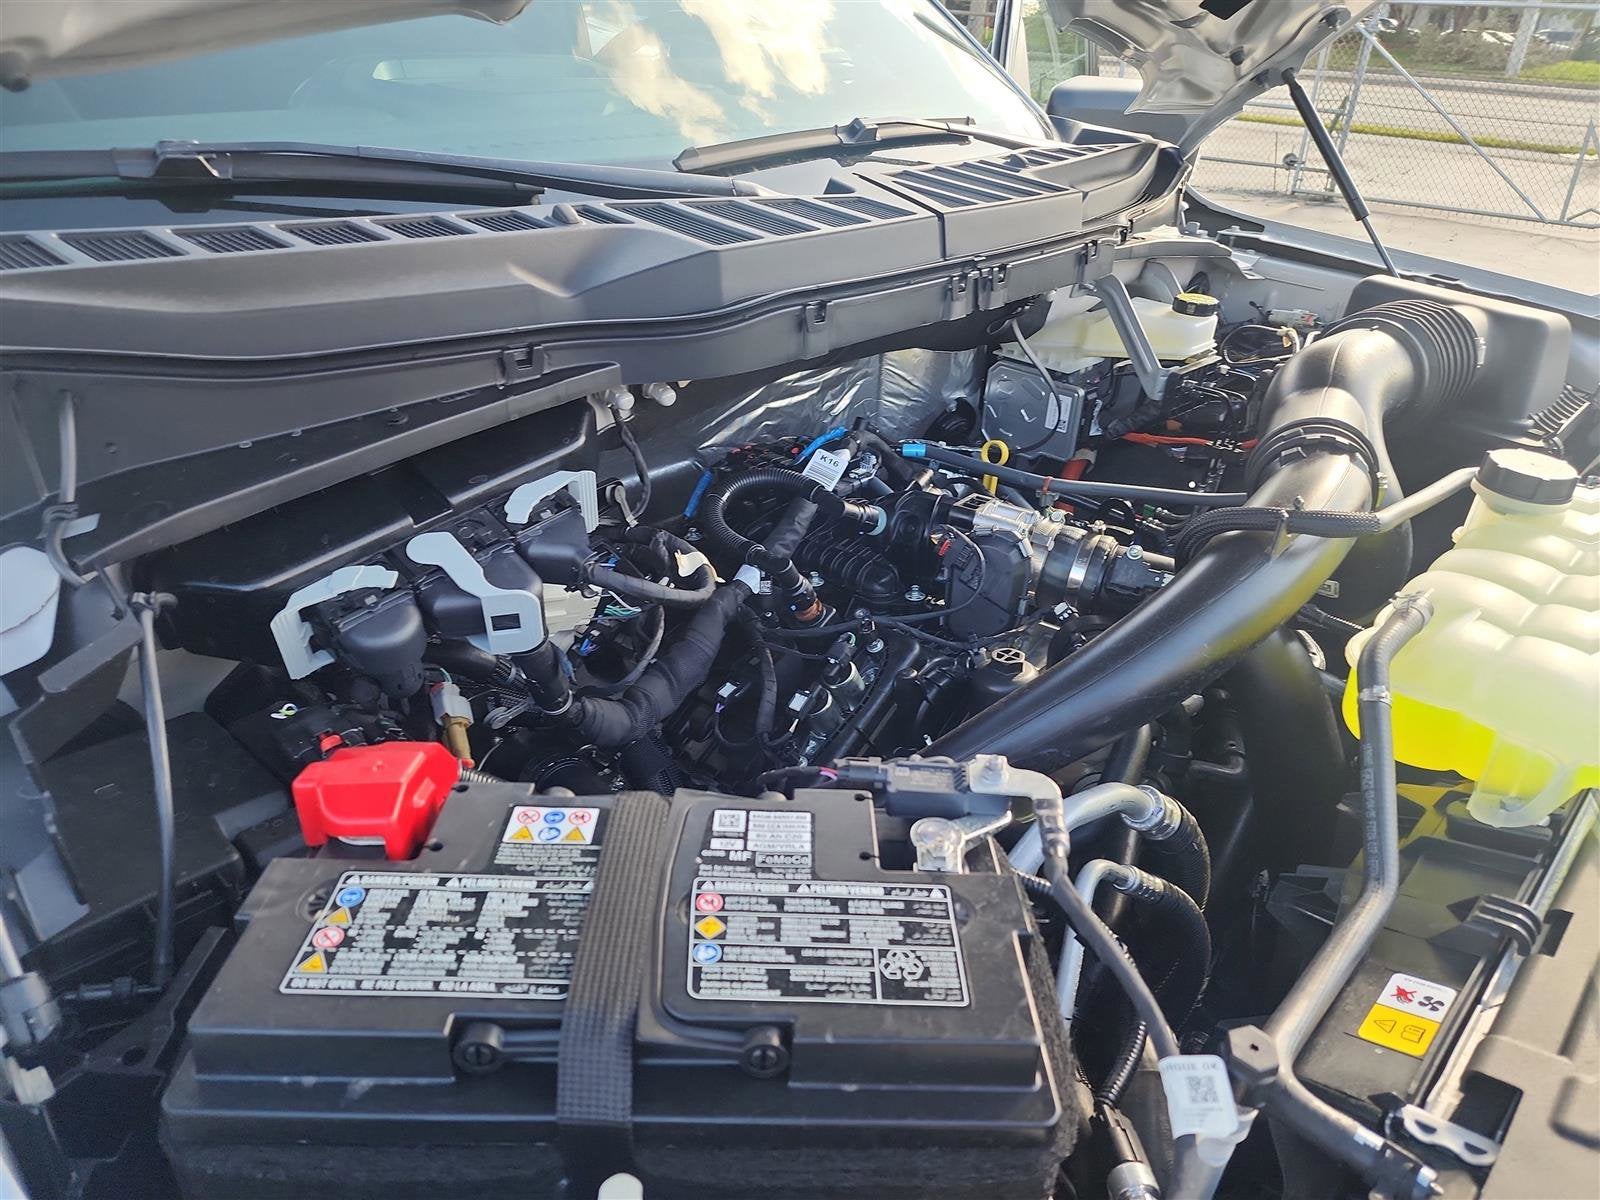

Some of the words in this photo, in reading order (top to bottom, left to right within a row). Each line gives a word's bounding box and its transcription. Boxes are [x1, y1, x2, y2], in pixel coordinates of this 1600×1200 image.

[820, 454, 839, 467] K16
[729, 850, 753, 861] MF
[759, 854, 809, 865] FoMoCo
